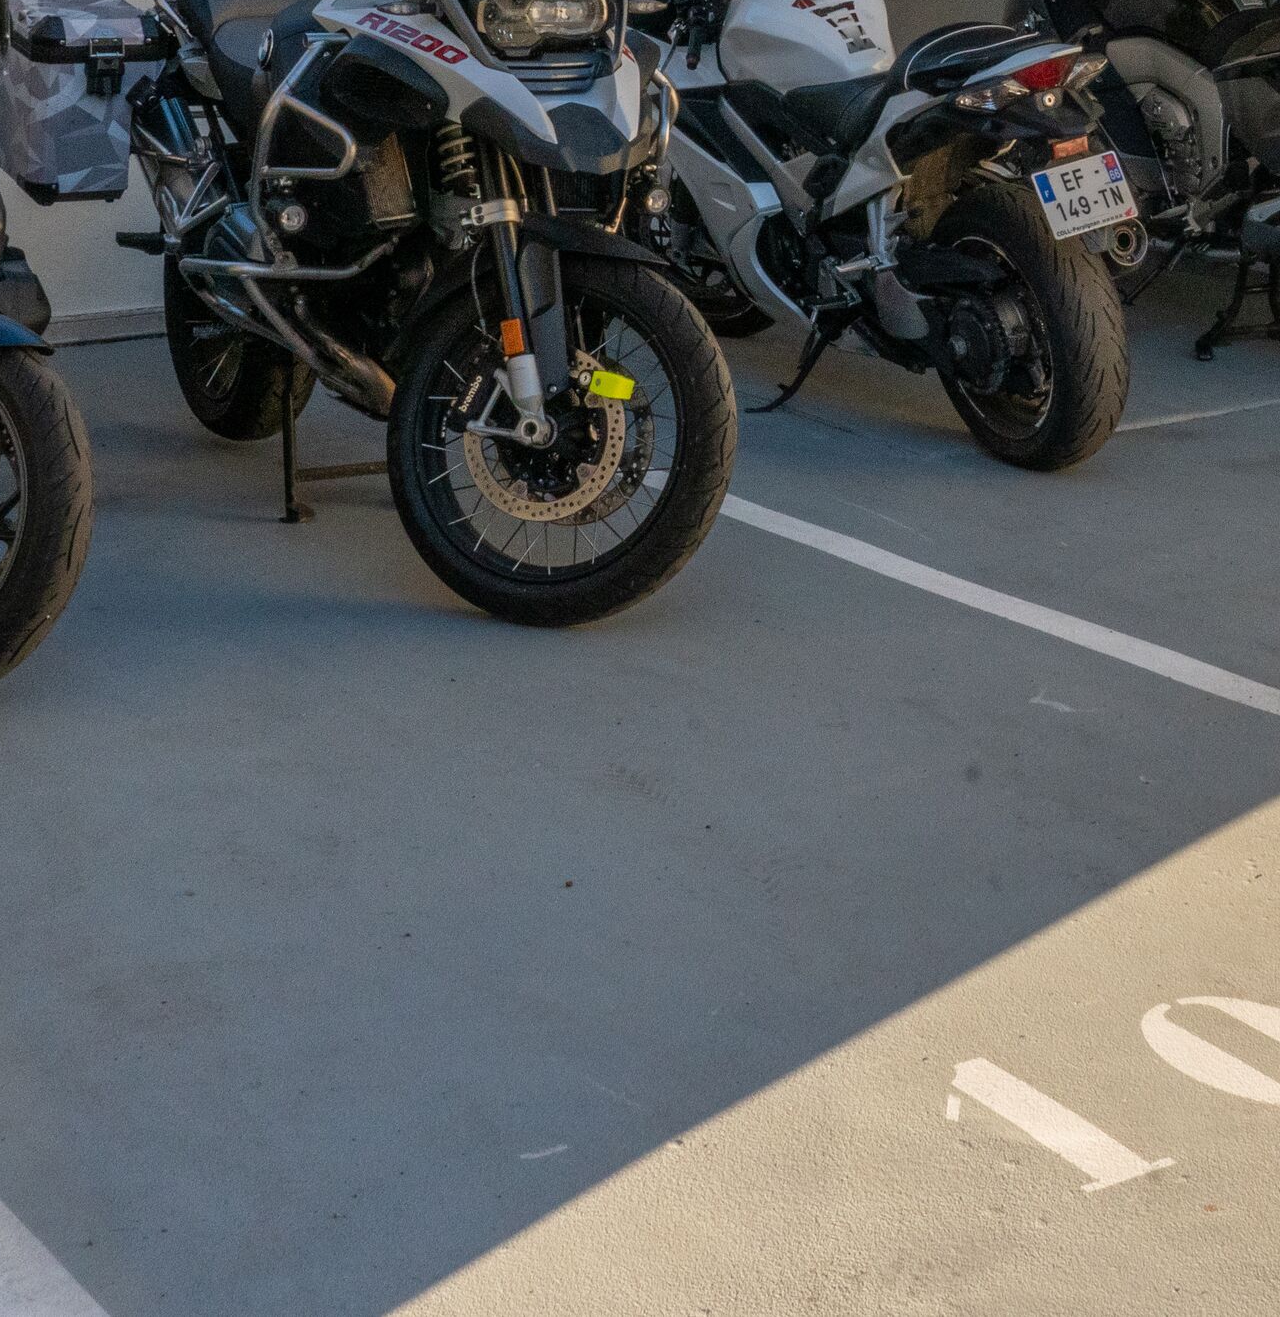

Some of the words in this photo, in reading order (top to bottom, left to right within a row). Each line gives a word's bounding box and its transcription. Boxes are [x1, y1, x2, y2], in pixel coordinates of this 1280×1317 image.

[356, 12, 469, 64] R1200
[1056, 185, 1125, 222] 149-TN
[458, 375, 483, 414] brembo
